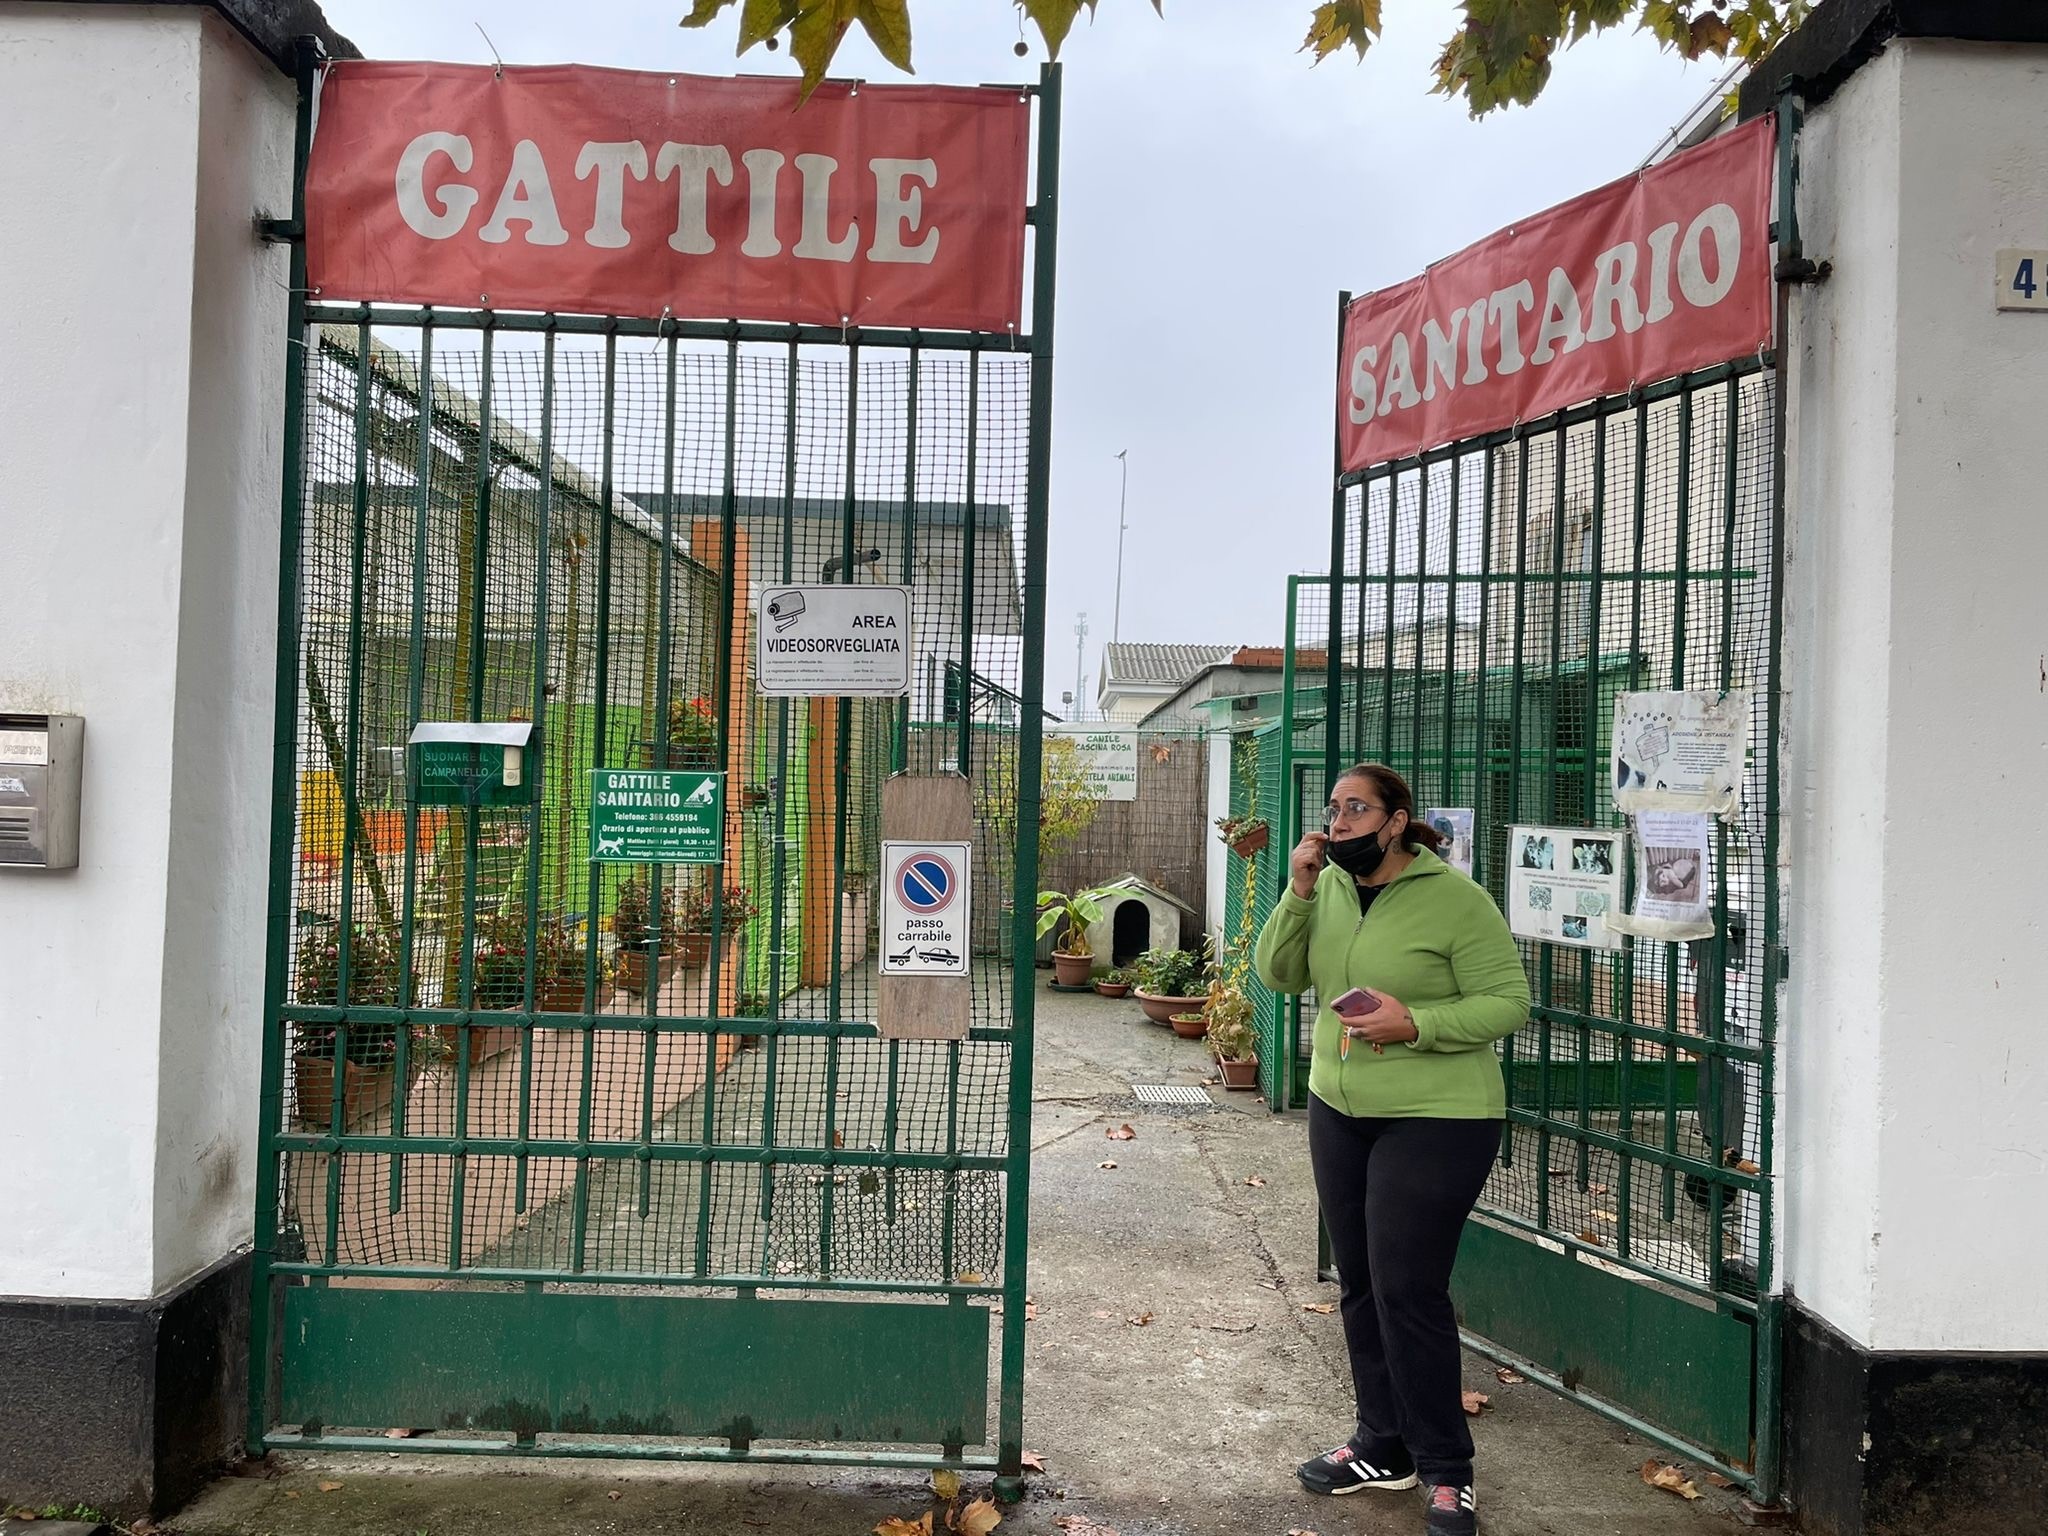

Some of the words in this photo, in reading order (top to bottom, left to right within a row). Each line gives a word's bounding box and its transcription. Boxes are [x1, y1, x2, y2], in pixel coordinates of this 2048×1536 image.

[395, 130, 940, 264] GATTILE
[2013, 258, 2048, 299] 4
[1348, 203, 1741, 425] SANITARIO
[852, 615, 897, 628] AREA
[766, 638, 901, 653] VIDEOSORVEGLIATA
[1086, 735, 1121, 743] CANILE
[3, 743, 43, 756] POSTA
[1075, 743, 1108, 751] CASCINA
[1111, 743, 1132, 751] ROSA
[424, 752, 477, 762] SUONARE
[479, 752, 489, 762] IL
[424, 767, 489, 777] CAMPANELLO
[1107, 773, 1135, 782] ANIMALI
[608, 774, 671, 789] GATTILE
[597, 792, 680, 807] SANITARIO
[614, 812, 648, 821] Telefono:
[601, 824, 625, 833] Orario
[626, 824, 634, 833] di
[635, 825, 668, 835] apertura
[669, 826, 677, 834] al
[678, 826, 711, 836] pubblico
[906, 919, 944, 930] passo
[897, 930, 952, 942] carrabile
